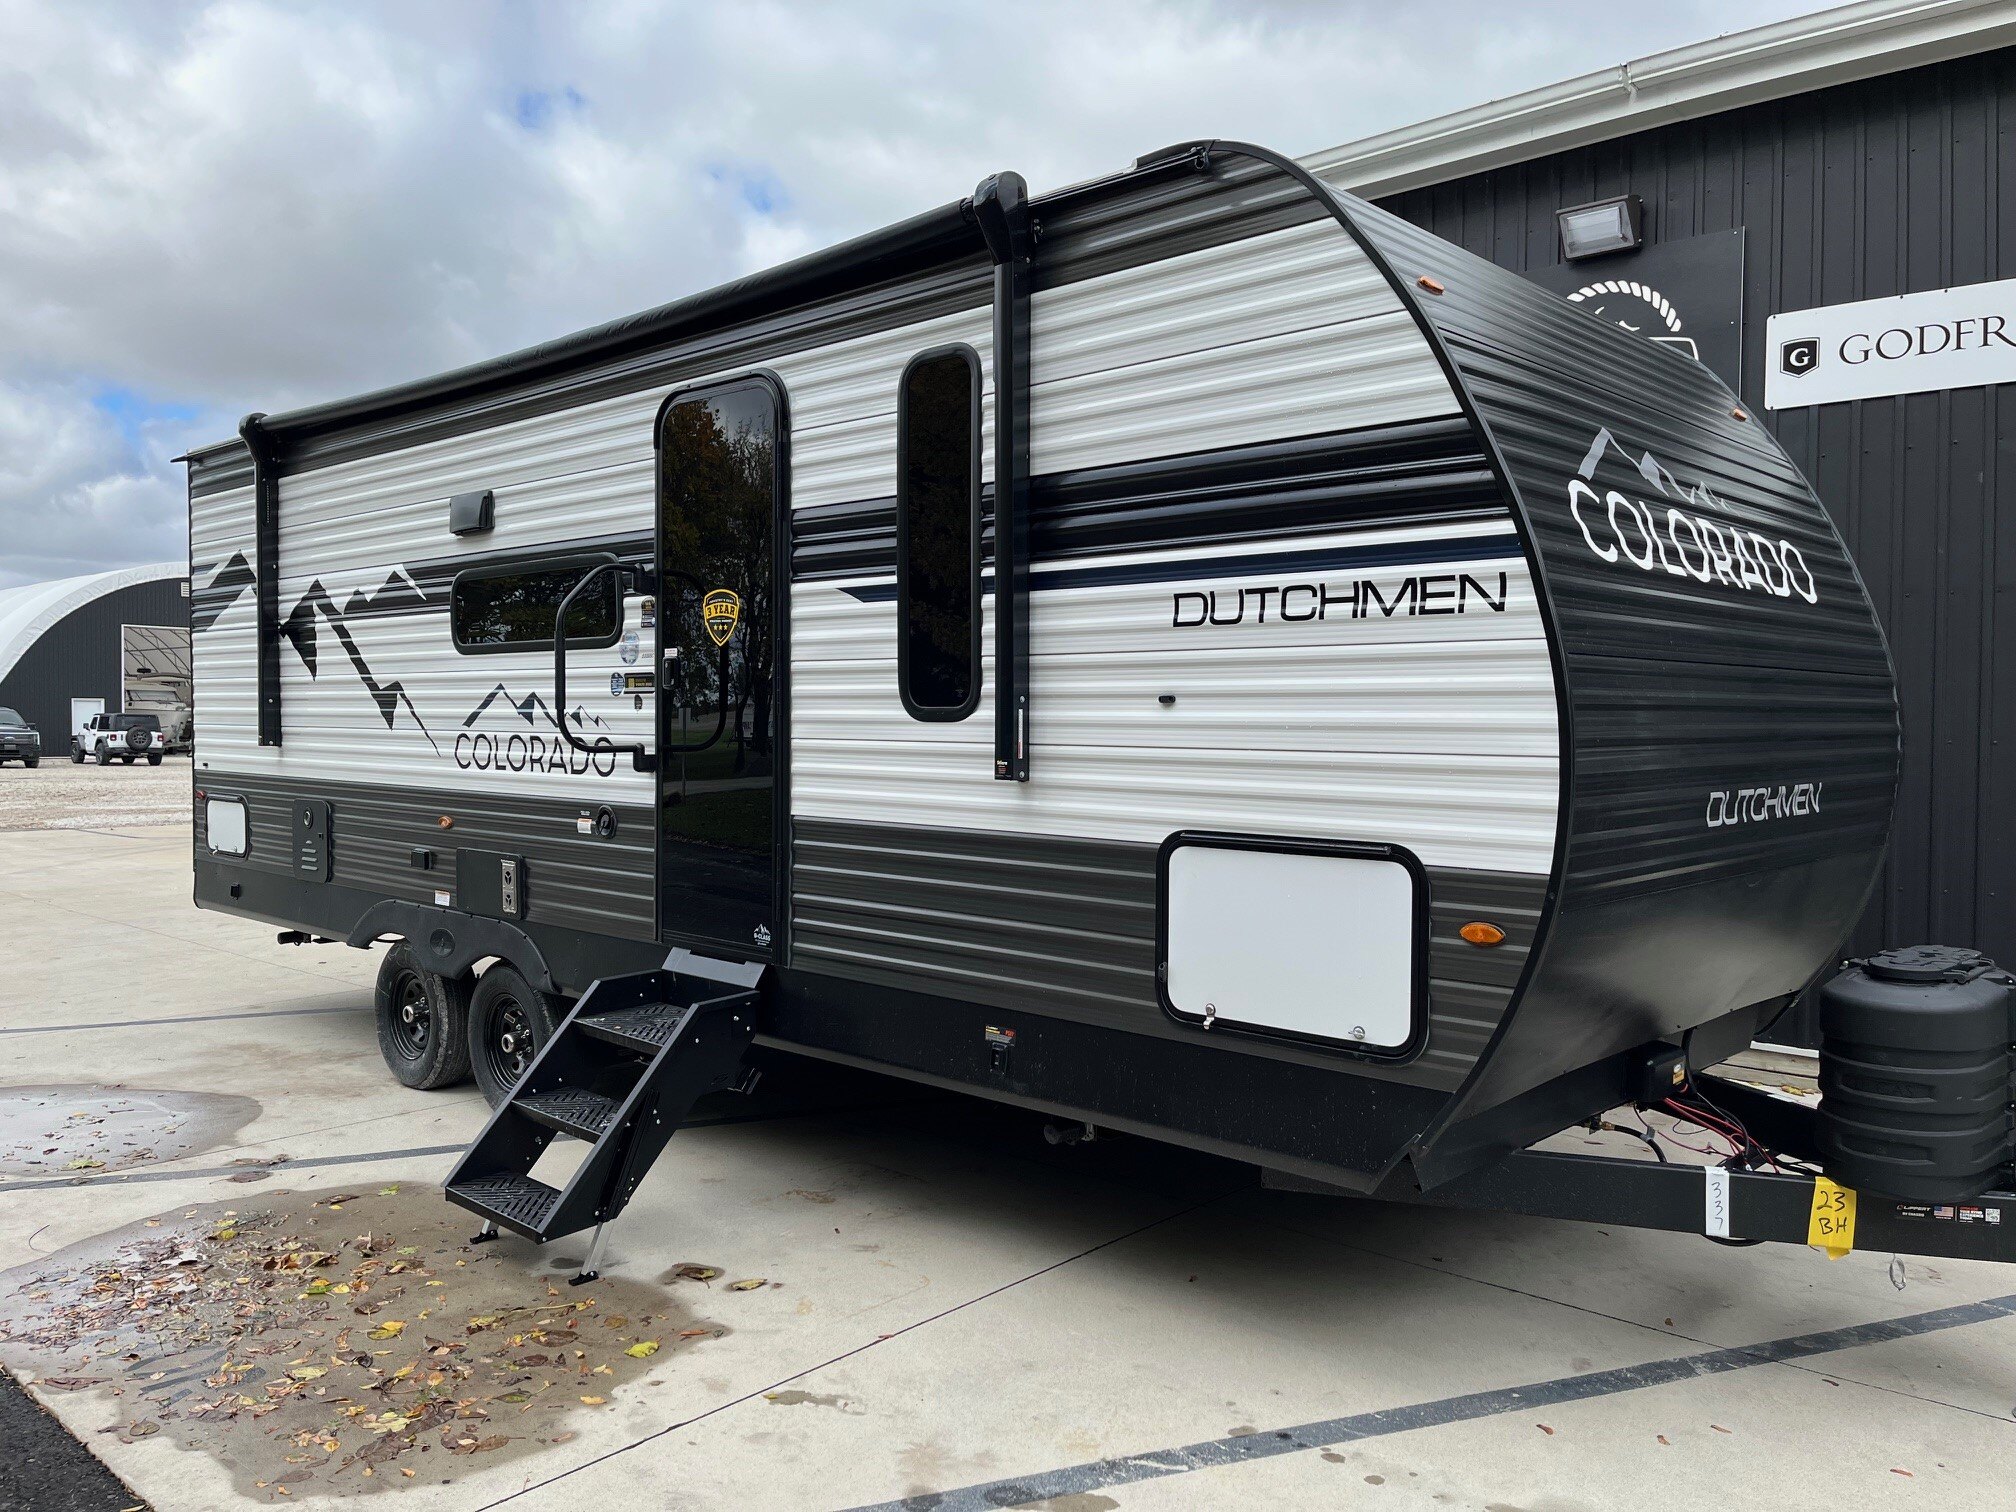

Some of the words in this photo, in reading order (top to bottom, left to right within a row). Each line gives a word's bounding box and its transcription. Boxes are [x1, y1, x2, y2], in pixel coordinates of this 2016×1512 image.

[1789, 347, 1811, 367] G
[1839, 315, 2016, 365] GODFR
[1567, 479, 1818, 605] COLORADO
[706, 606, 712, 617] 3
[713, 604, 736, 616] YEAR
[1172, 571, 1508, 628] DUTCHMEN
[454, 733, 617, 778] COLORADO
[1706, 782, 1822, 828] DUTCHMEN
[1816, 1190, 1846, 1212] 23
[1818, 1216, 1848, 1235] BH
